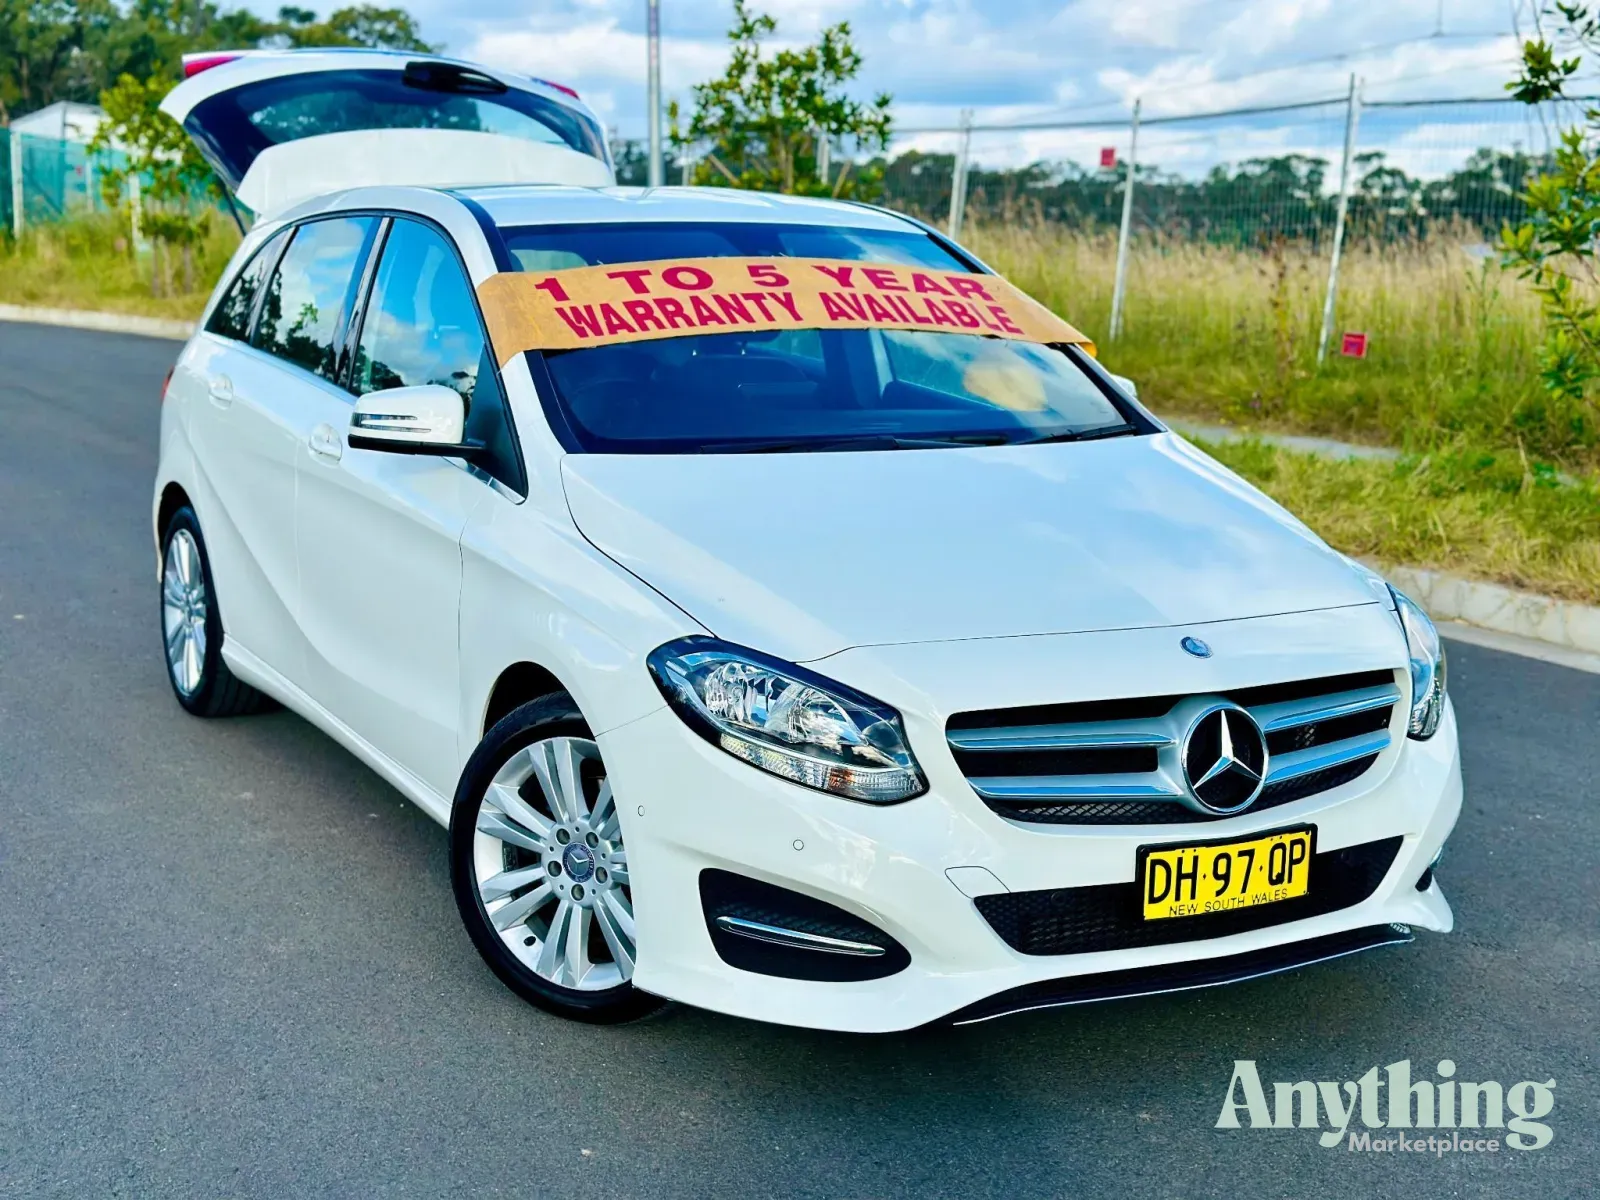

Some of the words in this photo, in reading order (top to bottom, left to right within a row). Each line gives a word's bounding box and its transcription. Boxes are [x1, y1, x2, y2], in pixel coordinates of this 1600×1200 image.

[535, 277, 570, 301] 1
[608, 267, 713, 293] TO
[746, 265, 789, 286] 5
[811, 265, 993, 301] YEAR
[555, 292, 801, 338] WARRANTY
[825, 297, 1024, 335] AVAILABLE
[1169, 904, 1199, 916] NEW
[1204, 896, 1245, 912] SOUTH
[1252, 888, 1288, 905] WALES
